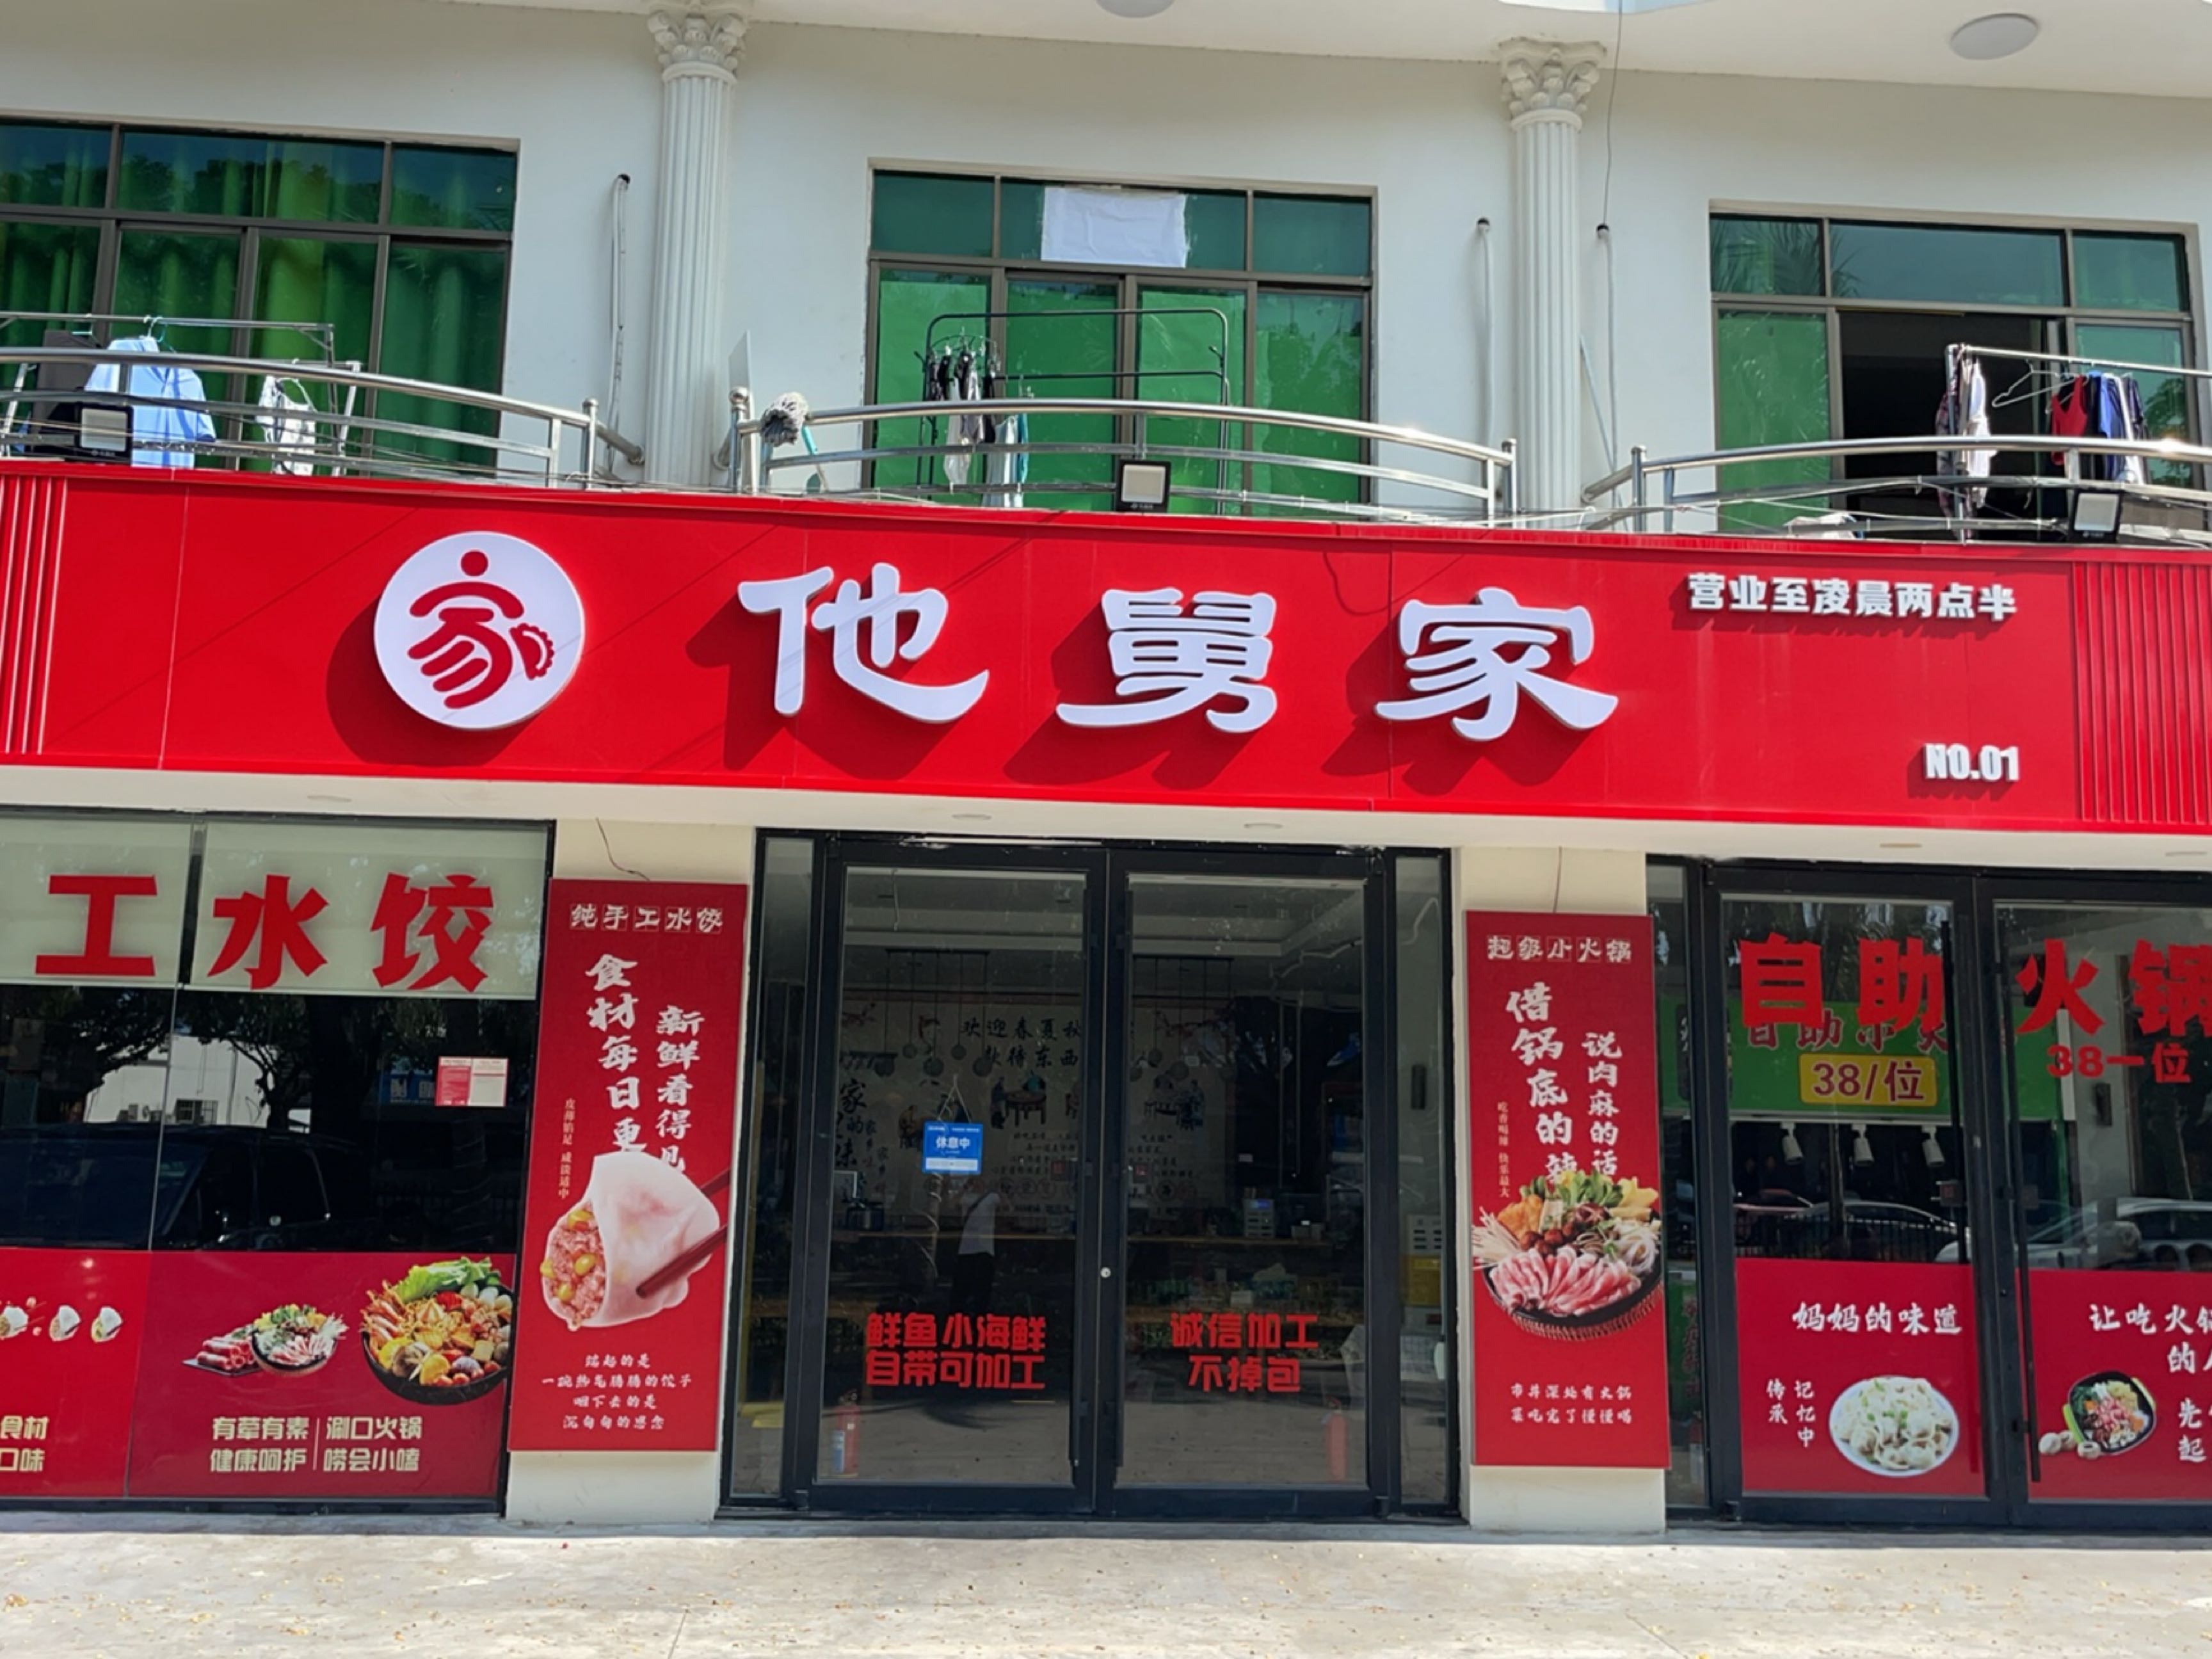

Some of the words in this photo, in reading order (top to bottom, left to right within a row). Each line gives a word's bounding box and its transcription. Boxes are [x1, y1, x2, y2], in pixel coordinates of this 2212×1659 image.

[1687, 572, 2017, 622] 营业至凌晨两点半
[738, 562, 1618, 743] 他舅家
[1925, 743, 2020, 782] NO.01
[570, 903, 724, 934] 纯手工水饺
[1813, 1060, 1925, 1102] 38/位
[1582, 1031, 1622, 1176] 说肉麻的话
[867, 1312, 1046, 1352] 鲜鱼小海鲜
[1171, 1311, 1319, 1350] 诚信加工
[1791, 1301, 1963, 1336] 妈妈的味道
[865, 1352, 1046, 1390] 自带可加工
[1189, 1354, 1301, 1393] 不掉包
[0, 1415, 49, 1440] 食材
[212, 1416, 310, 1441] 有荤有素
[326, 1415, 423, 1440] 涮口火锅
[1793, 1379, 1816, 1448] 记忆中
[0, 1447, 45, 1472] 口味
[210, 1448, 307, 1473] 健康呵护
